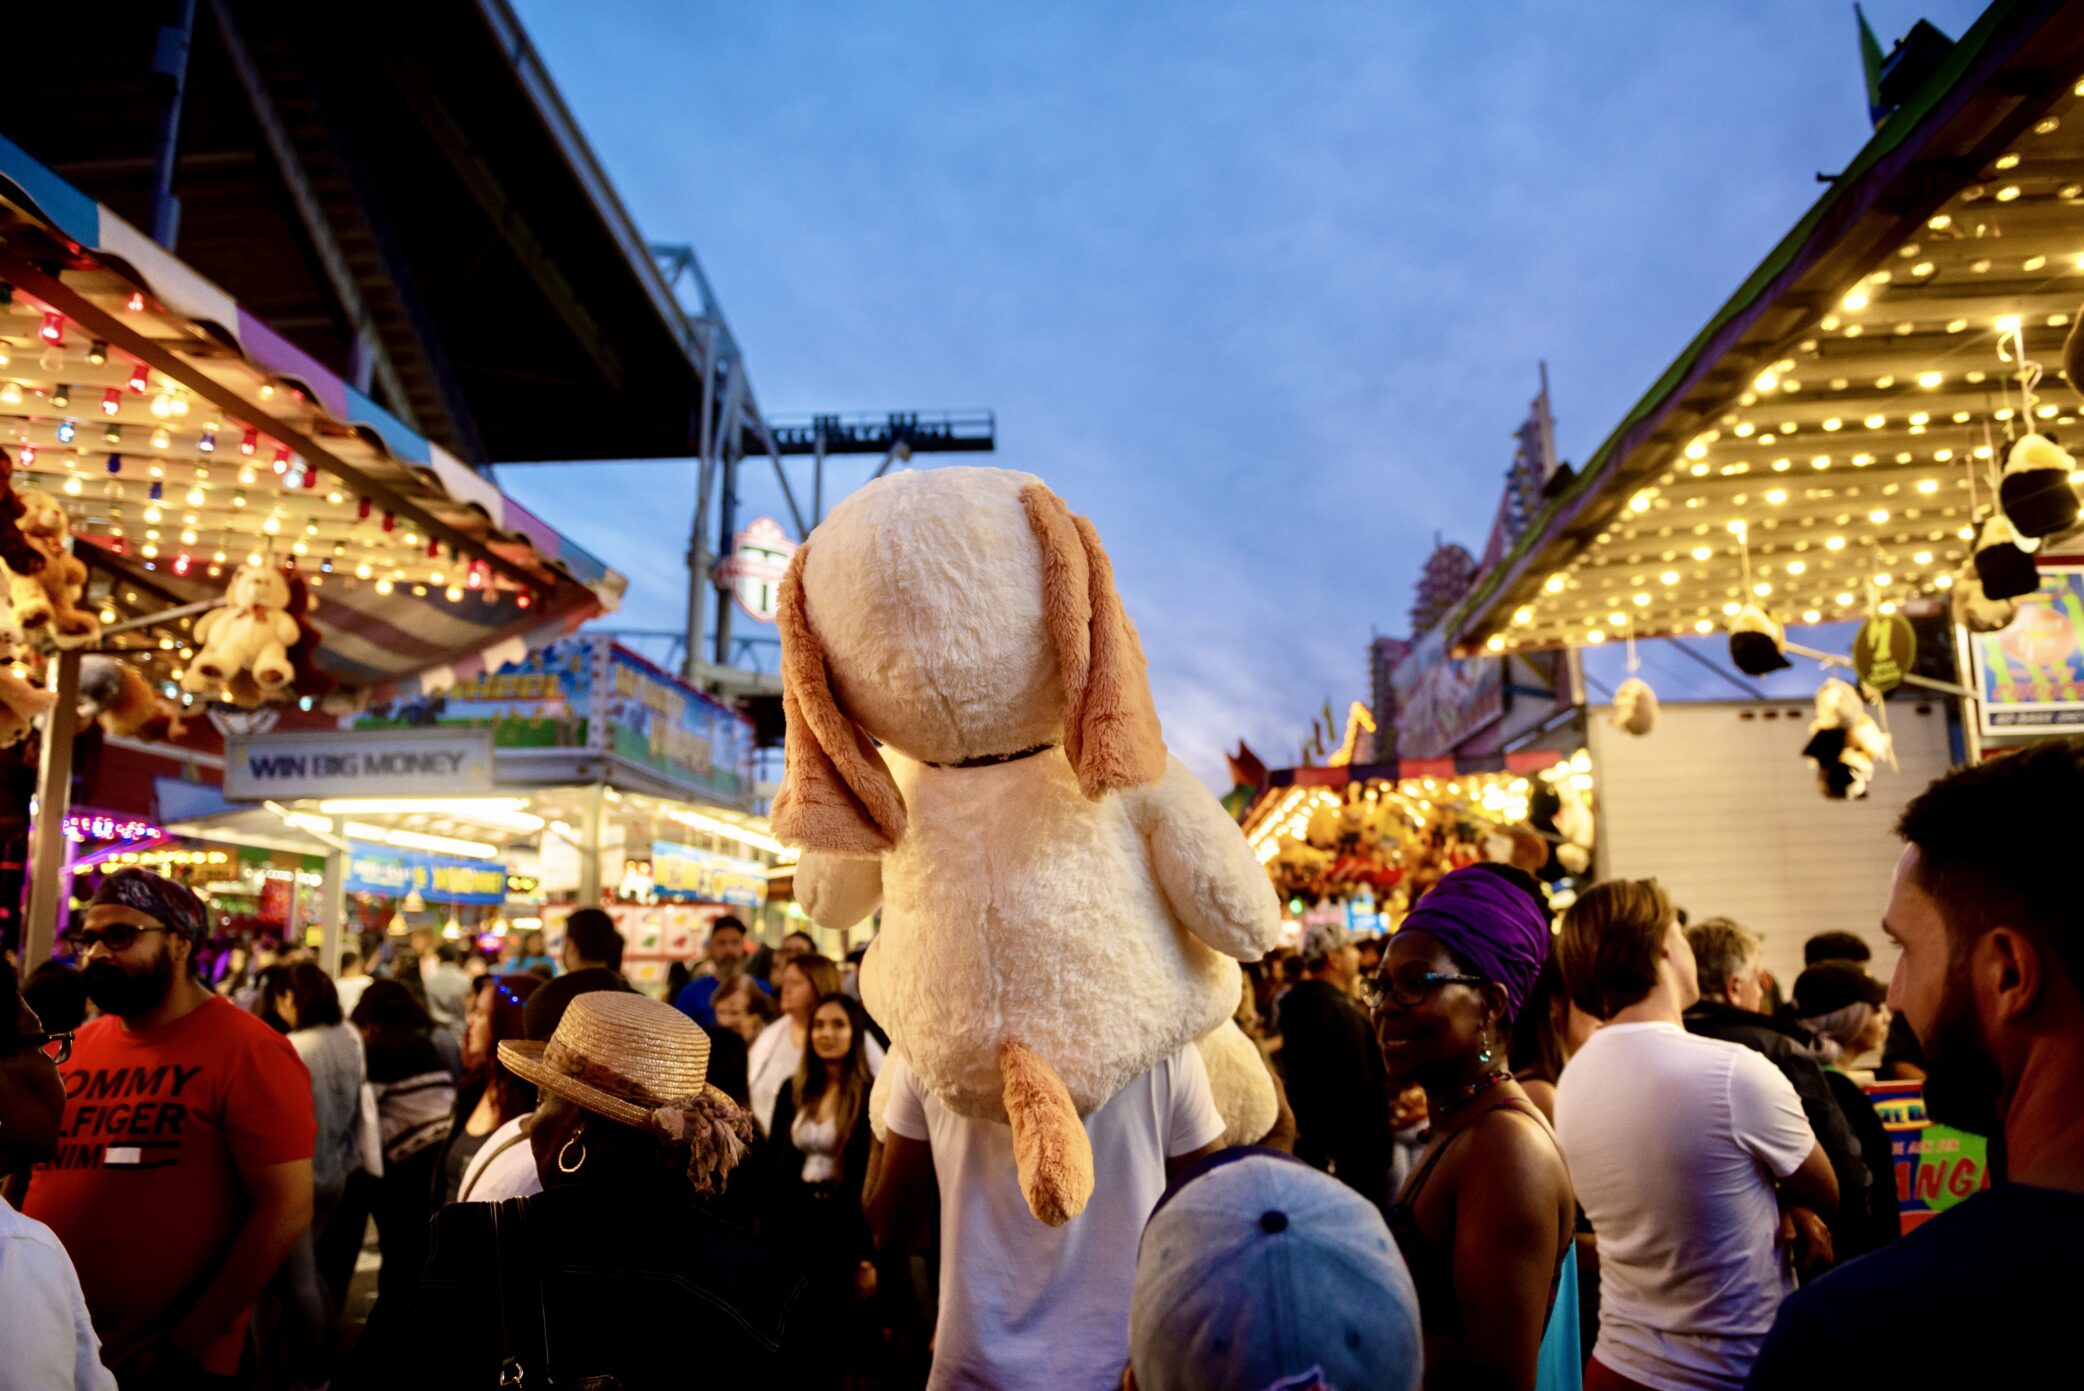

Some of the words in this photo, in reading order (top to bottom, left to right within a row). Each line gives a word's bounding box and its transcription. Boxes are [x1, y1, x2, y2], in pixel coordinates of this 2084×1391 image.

[249, 755, 306, 779] WIN
[312, 754, 358, 777] BIG
[363, 752, 465, 777] MONEY
[61, 1065, 203, 1099] OMMY
